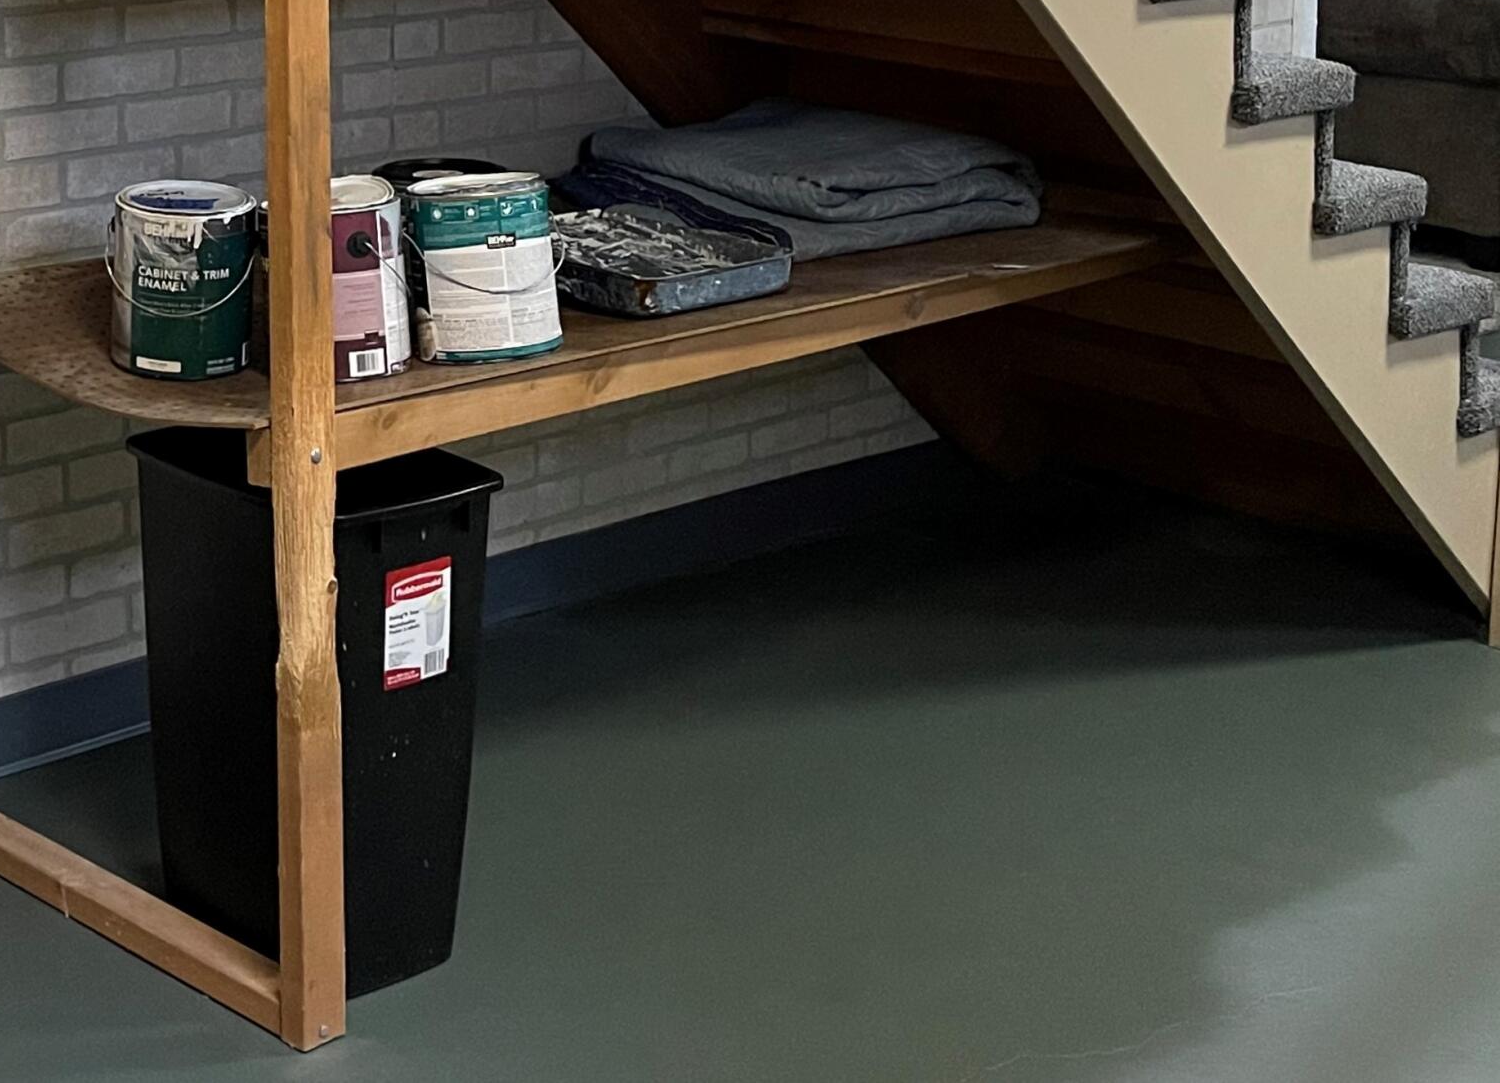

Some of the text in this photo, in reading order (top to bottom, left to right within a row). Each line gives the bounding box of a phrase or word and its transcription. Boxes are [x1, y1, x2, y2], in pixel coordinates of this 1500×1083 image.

[138, 265, 229, 280] CABINET & TRIM
[138, 276, 187, 292] ENAMEL
